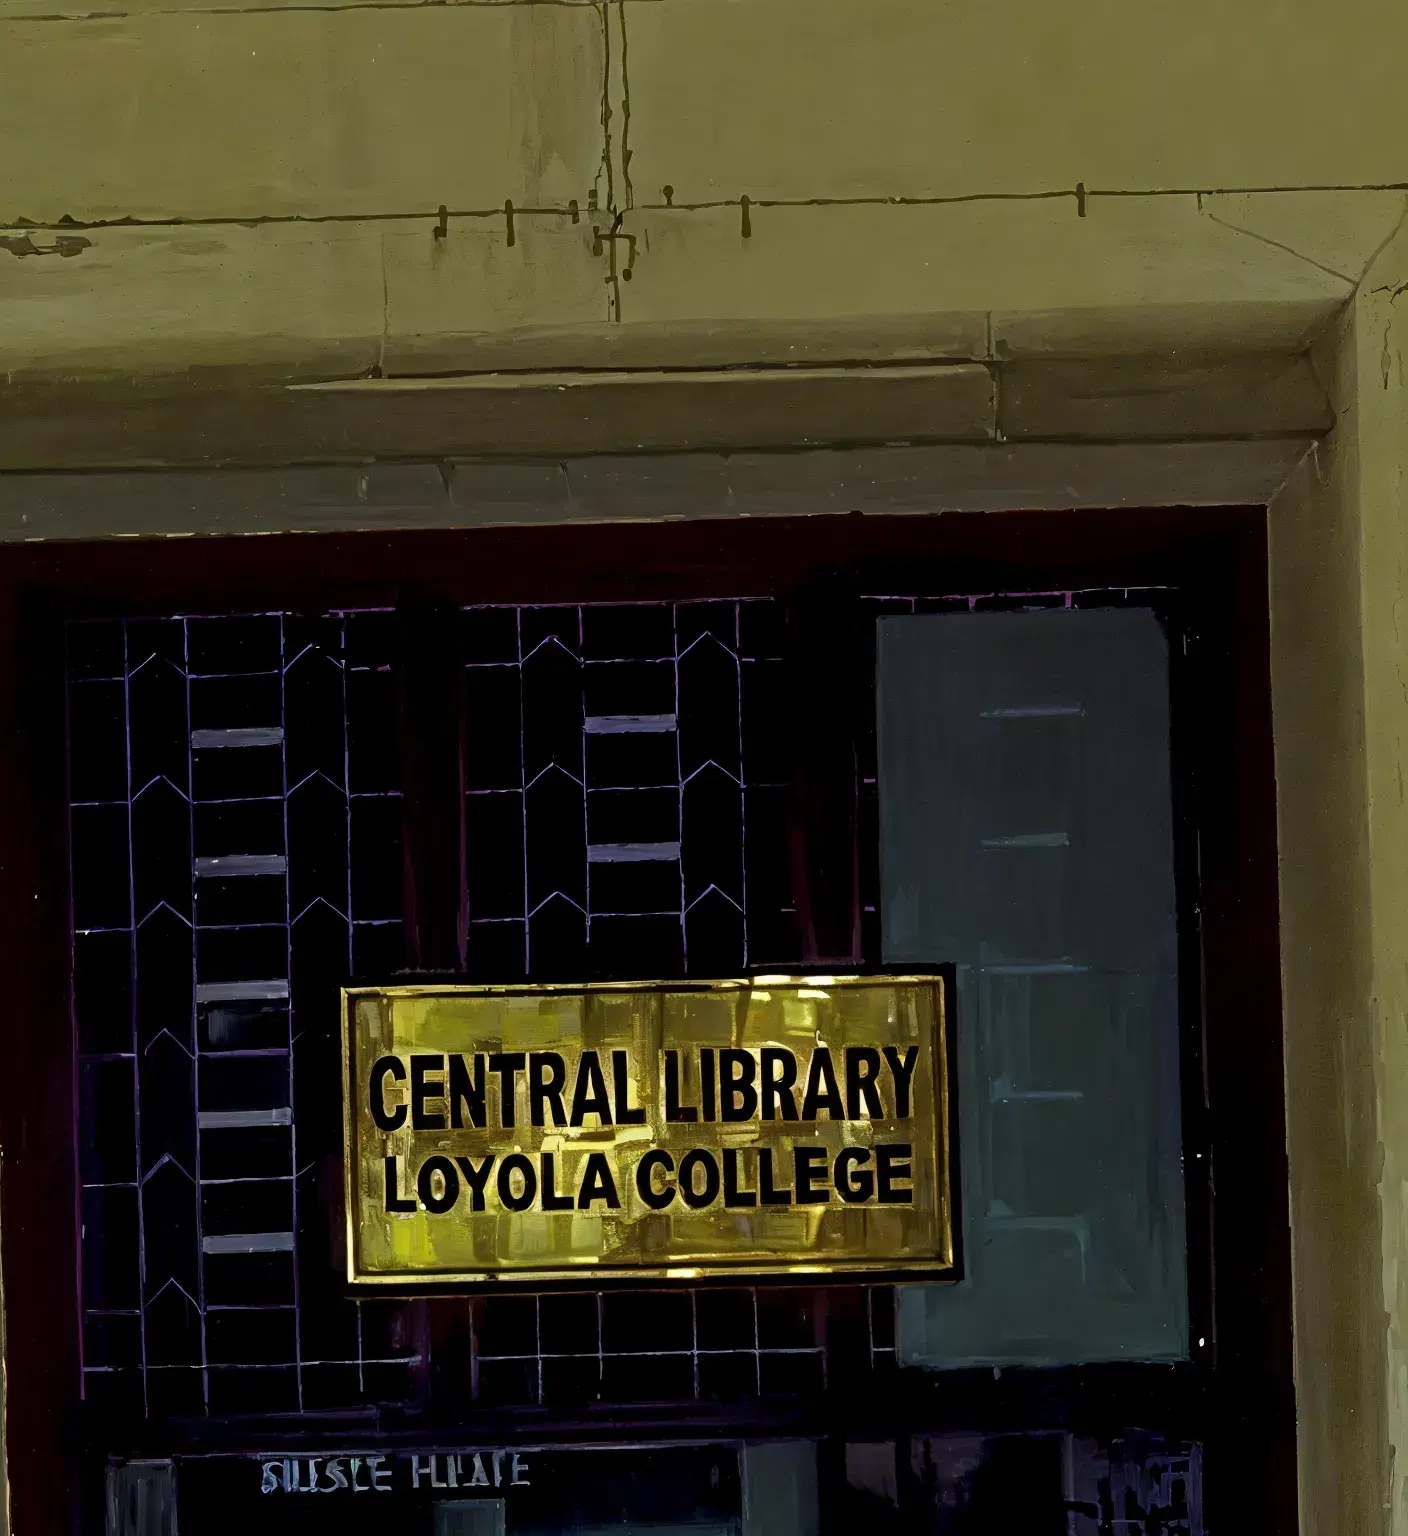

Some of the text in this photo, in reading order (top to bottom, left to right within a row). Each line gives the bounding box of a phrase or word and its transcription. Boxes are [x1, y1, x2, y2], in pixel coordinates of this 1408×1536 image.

[368, 1045, 920, 1132] CENTRAL LIBRARY
[383, 1143, 914, 1214] LOYOLA COLLEGE
